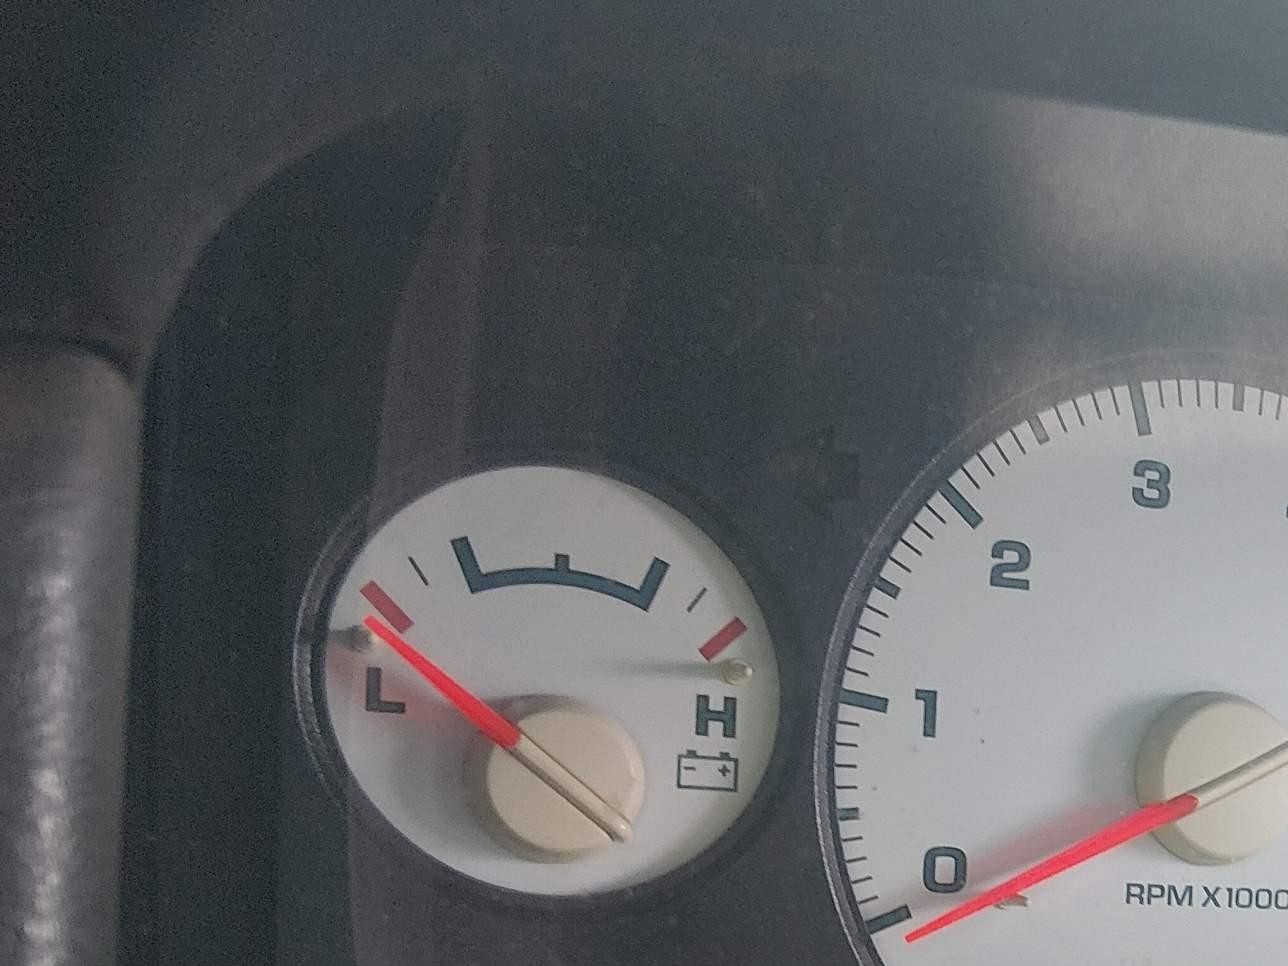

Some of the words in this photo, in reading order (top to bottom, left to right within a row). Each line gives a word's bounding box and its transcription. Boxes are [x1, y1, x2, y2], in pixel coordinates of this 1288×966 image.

[1132, 459, 1172, 508] 3
[990, 540, 1031, 590] 2
[366, 667, 405, 713] L
[915, 689, 938, 737] 1
[696, 694, 738, 738] H
[923, 846, 967, 893] 0
[1125, 883, 1193, 907] RPM
